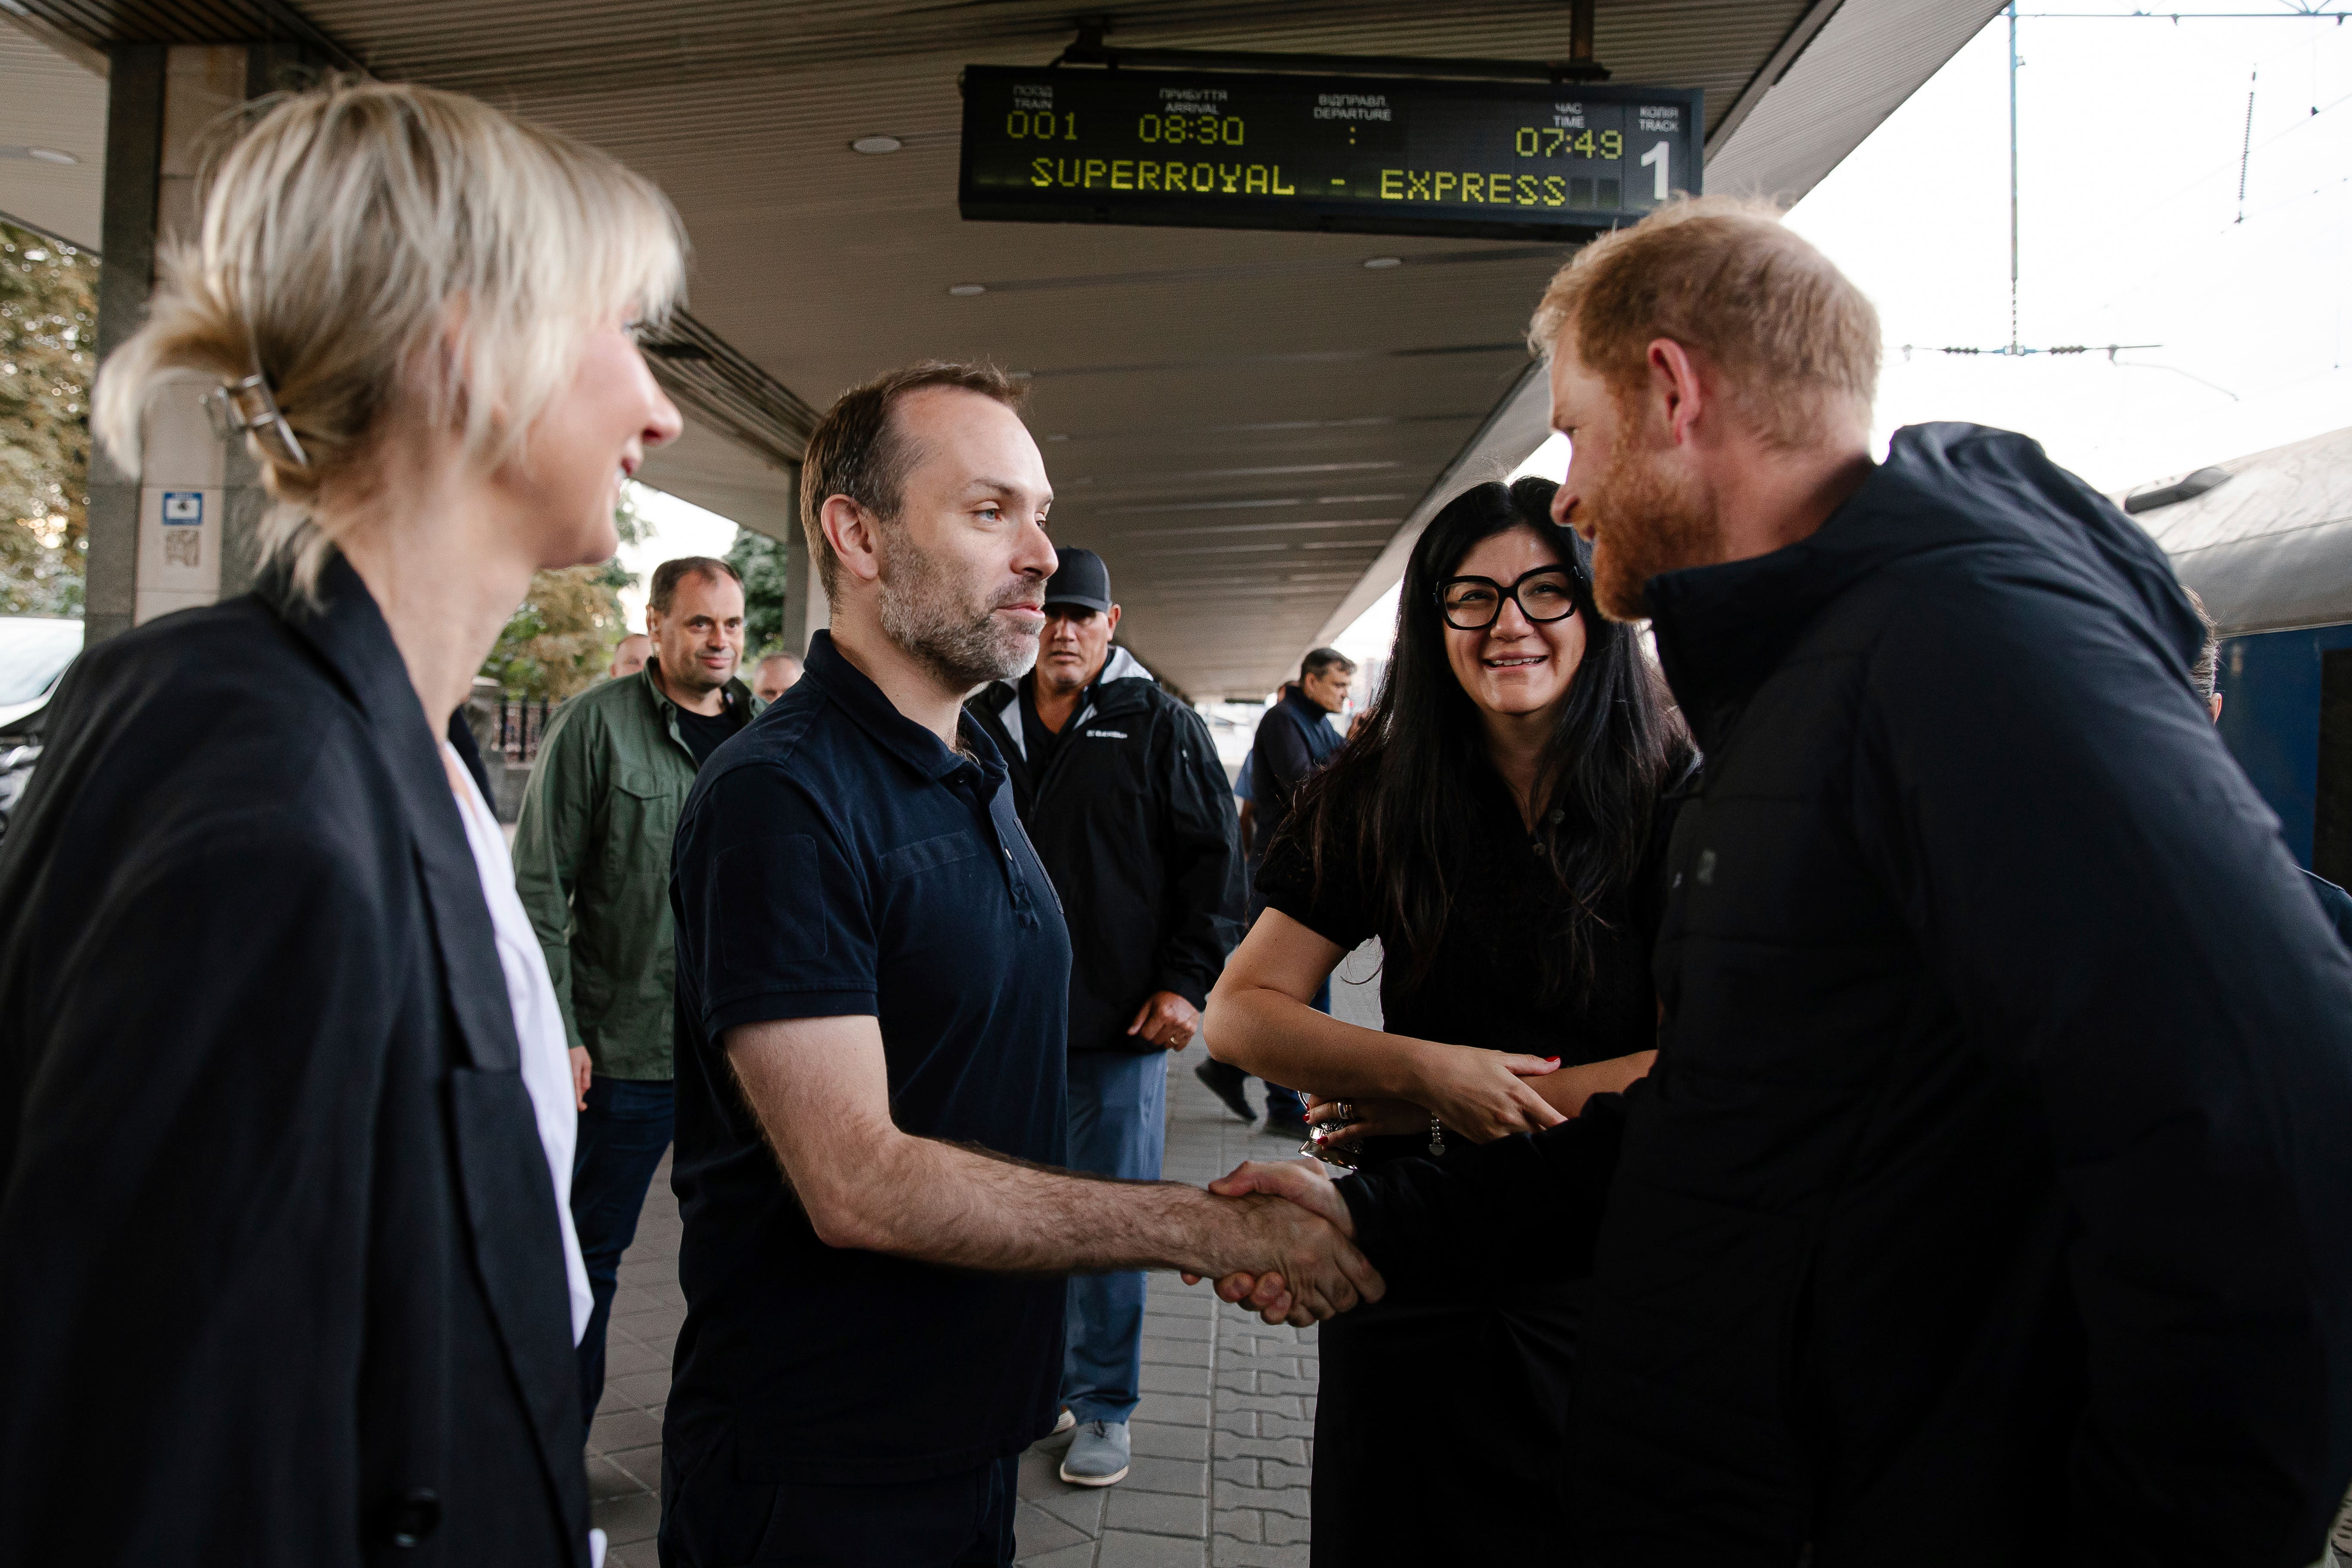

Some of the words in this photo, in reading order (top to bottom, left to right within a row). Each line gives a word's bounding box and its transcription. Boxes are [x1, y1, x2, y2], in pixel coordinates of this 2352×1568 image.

[1014, 98, 1053, 110] TRAIN
[1165, 102, 1220, 115] ARRIVAL
[1555, 103, 1583, 115] ЧАС
[1313, 107, 1392, 121] DEPARTURE
[1007, 111, 1077, 140] 001
[1553, 115, 1585, 128] TIME
[1639, 118, 1679, 132] TRACK
[1139, 114, 1244, 146] 08:30
[1515, 127, 1622, 159] 07:49
[1641, 141, 1670, 200] 1
[1031, 158, 1295, 195] SUPERROYAL
[1380, 169, 1566, 206] EXPRESS
